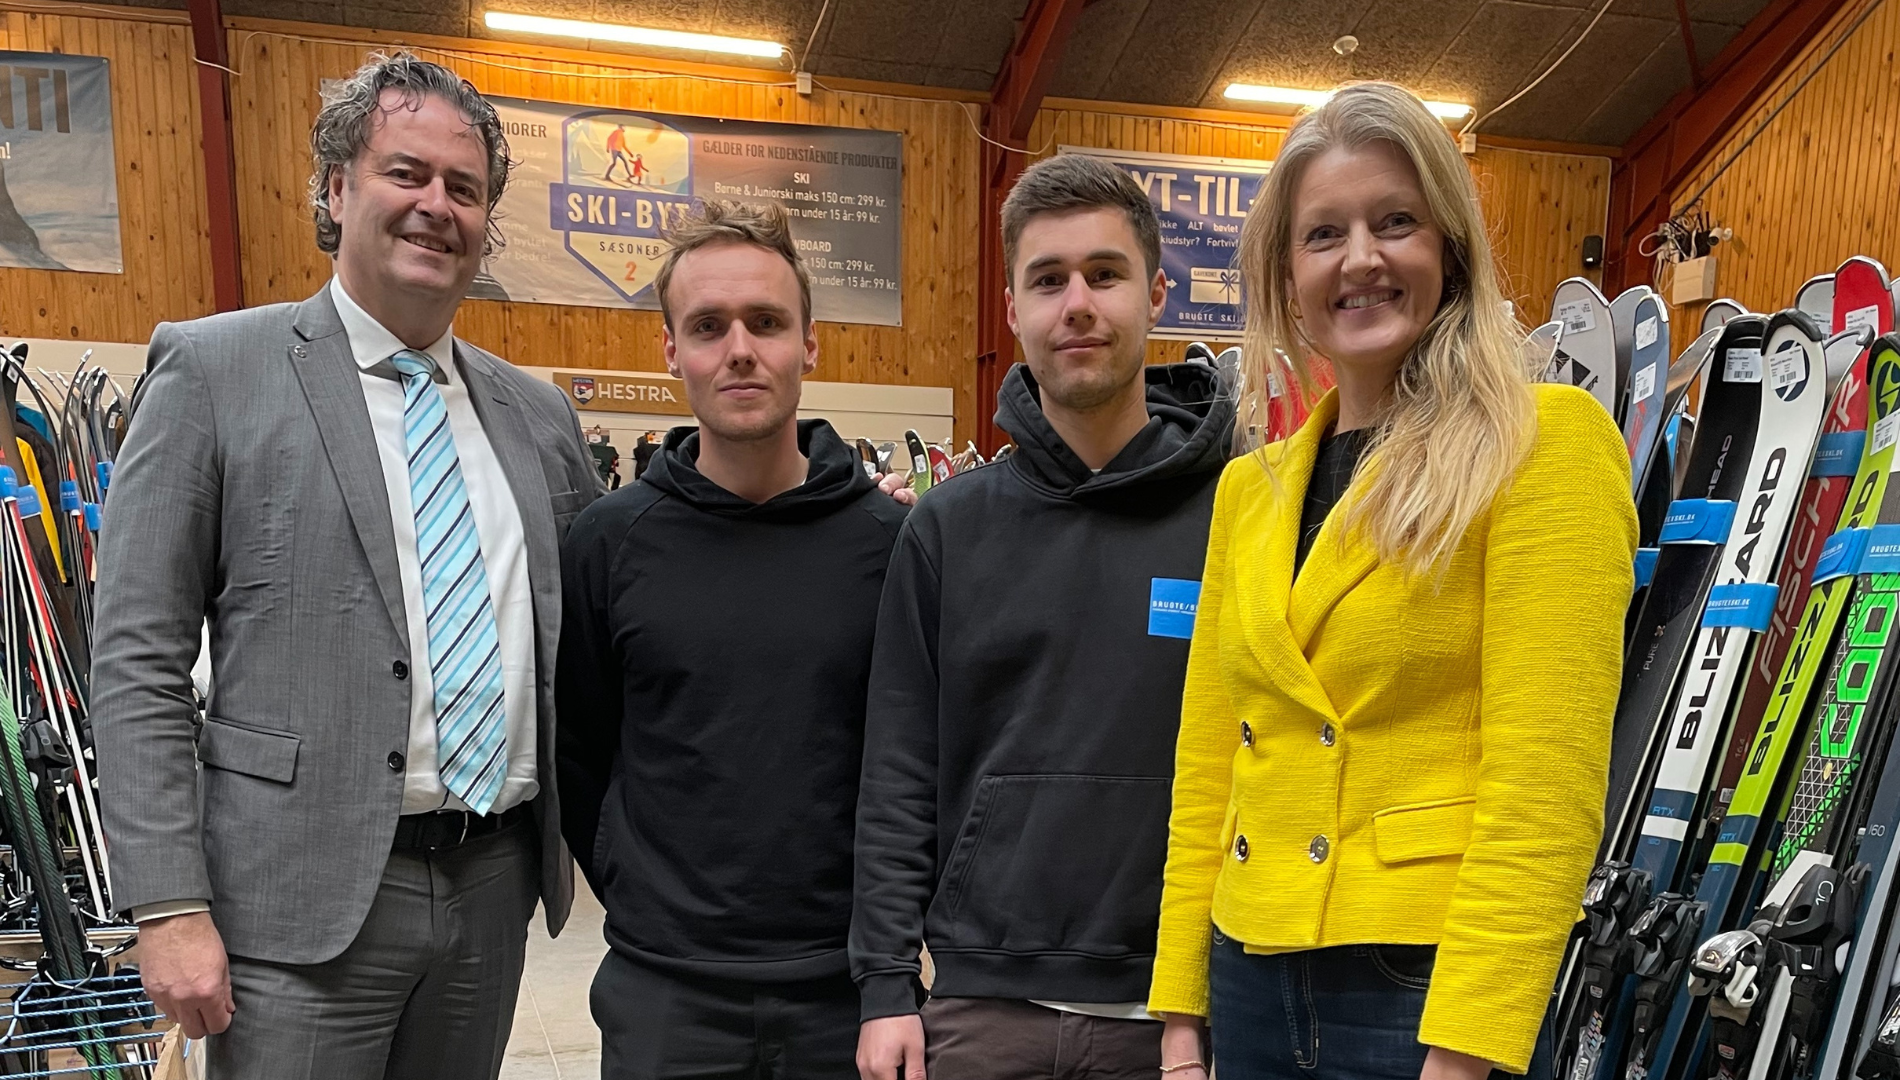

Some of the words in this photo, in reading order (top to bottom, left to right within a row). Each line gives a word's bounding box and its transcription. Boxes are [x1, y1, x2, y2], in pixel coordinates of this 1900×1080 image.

[703, 140, 743, 156] GÆLDER
[745, 143, 765, 158] FOR
[767, 146, 839, 165] NEDENSTÅENDE
[841, 152, 897, 170] PRODUKTER
[793, 172, 810, 184] SKI
[714, 182, 742, 195] Børne
[743, 184, 751, 196] &
[752, 186, 794, 200] Juniorski
[795, 190, 819, 202] maks
[821, 191, 838, 203] 150
[839, 195, 855, 205] cm:
[857, 195, 874, 206] 299
[875, 196, 887, 208] kr.
[567, 192, 690, 231] SKI-BYT
[801, 207, 828, 219] under
[830, 209, 840, 221] 15
[842, 210, 855, 222] år:
[856, 211, 868, 222] 99
[869, 213, 880, 224] kr.
[1187, 221, 1204, 231] ALT
[599, 241, 660, 255] SÆSONER
[1160, 235, 1200, 247] kiudstyr?
[624, 261, 637, 281] 2
[810, 257, 826, 268] 150
[828, 261, 845, 270] cm:
[846, 260, 862, 271] 299
[864, 261, 876, 272] kr.
[819, 276, 845, 286] under
[847, 277, 858, 287] 15
[860, 277, 872, 288] år:
[873, 278, 885, 289] 99
[886, 279, 898, 290] kr.
[1178, 312, 1214, 322] BRUGTE
[597, 382, 677, 403] HESTRA
[1705, 434, 1733, 499] HEAD
[1643, 643, 1660, 671] PURE
[1652, 805, 1675, 816] RTX
[1869, 823, 1886, 836] 160
[1720, 832, 1738, 842] RTX
